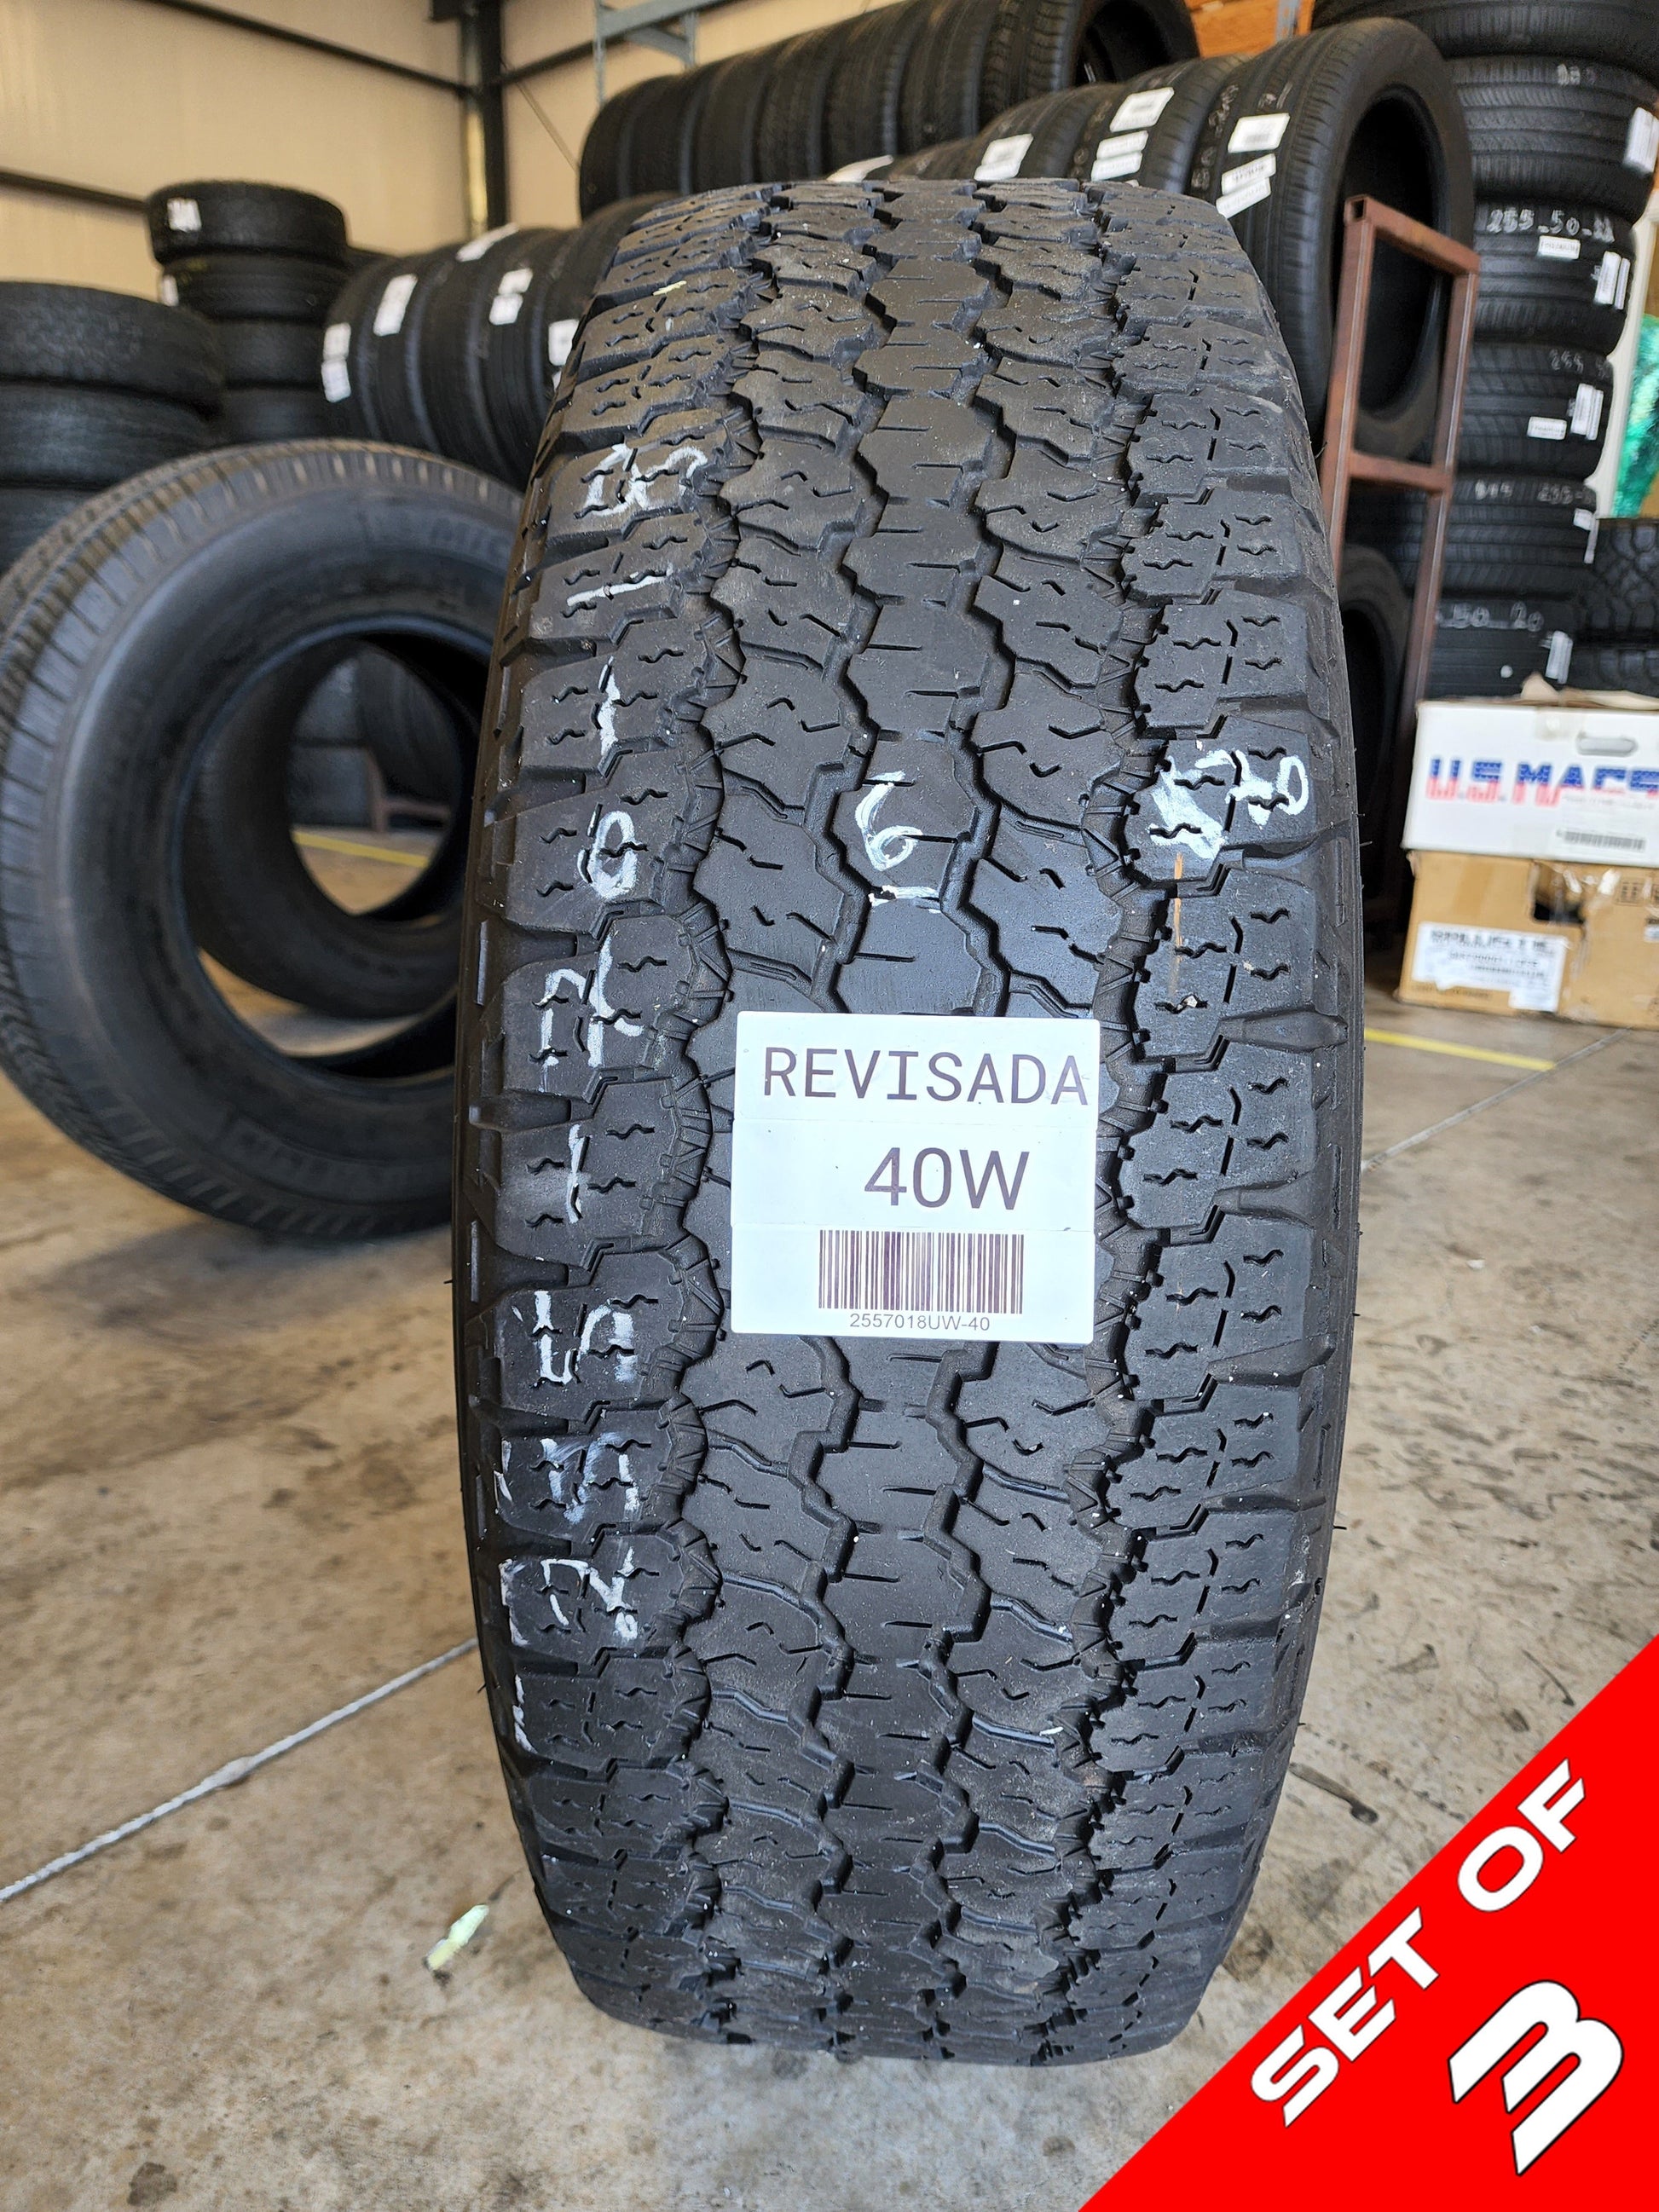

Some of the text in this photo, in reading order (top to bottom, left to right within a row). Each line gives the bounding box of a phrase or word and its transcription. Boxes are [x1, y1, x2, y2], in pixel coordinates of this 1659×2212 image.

[763, 1046, 1089, 1106] REVISADA
[864, 1146, 1031, 1210] 40W
[849, 1313, 991, 1331] 2557018UW-40
